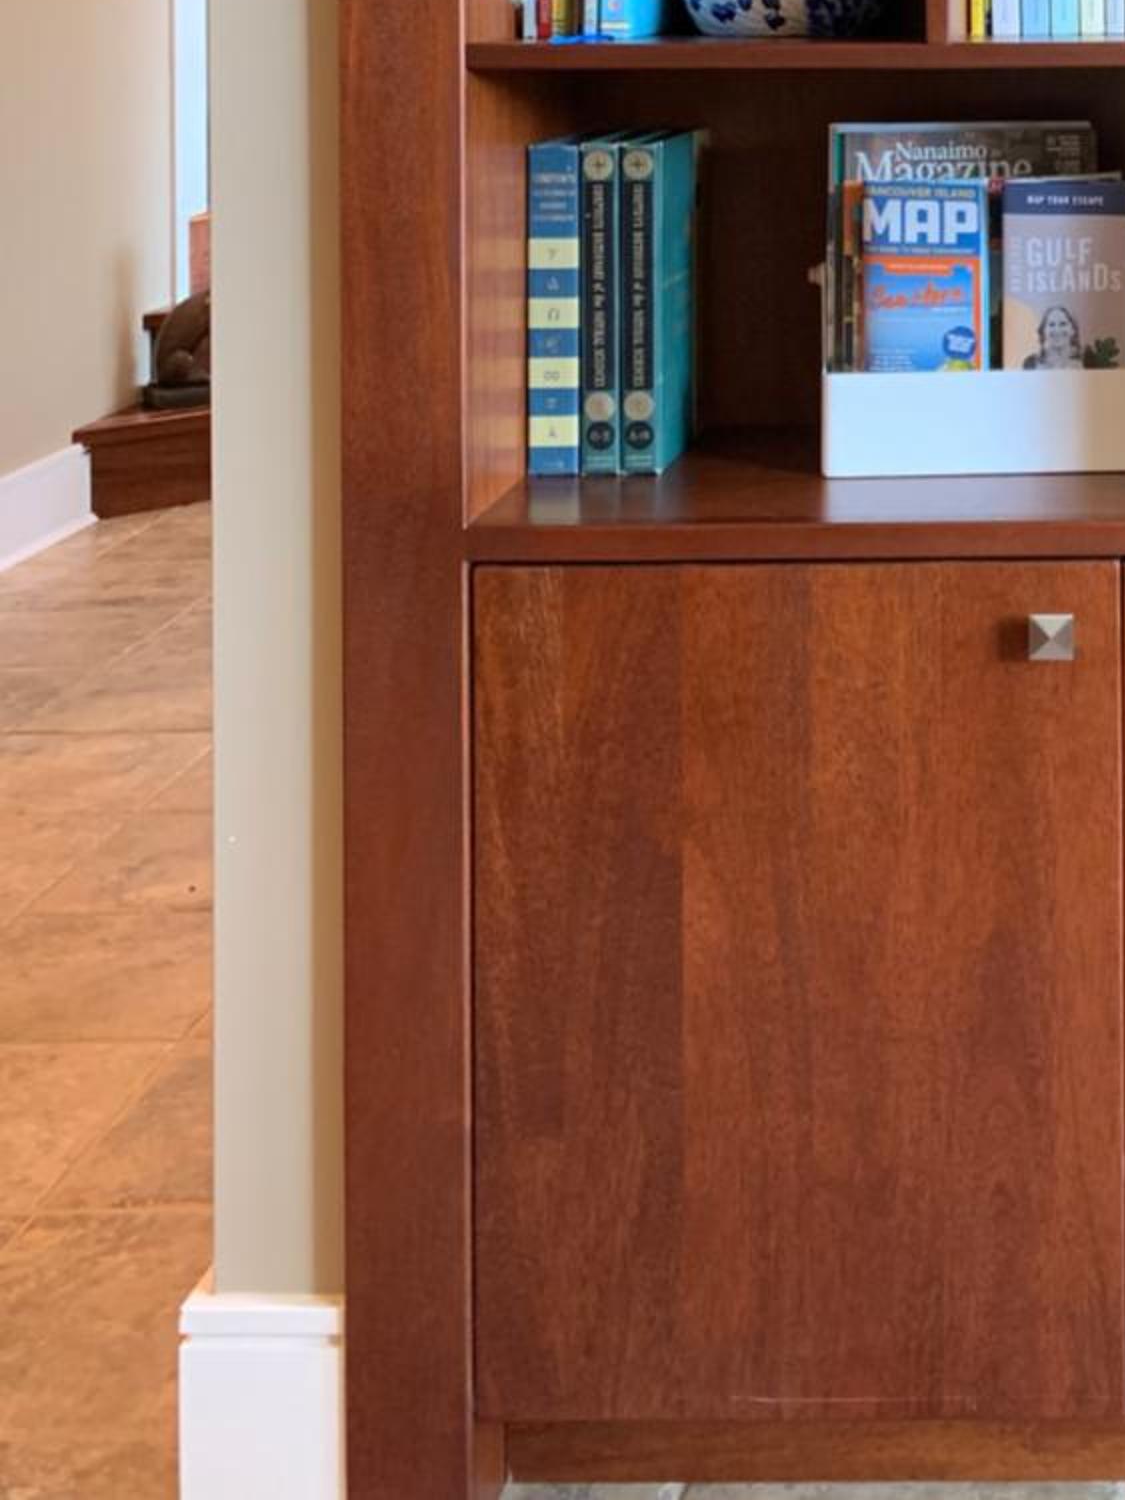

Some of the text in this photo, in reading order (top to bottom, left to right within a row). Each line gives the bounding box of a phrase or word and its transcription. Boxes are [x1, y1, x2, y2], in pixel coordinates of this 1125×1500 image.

[855, 150, 1033, 182] Magazine
[894, 141, 987, 161] Nanaimo
[933, 186, 976, 198] ISLAND
[1027, 195, 1046, 205] MAP
[1072, 195, 1104, 206] ESCAPE
[864, 198, 979, 244] MAP
[1026, 236, 1094, 267] GULF
[1026, 262, 1122, 292] ISLANDS
